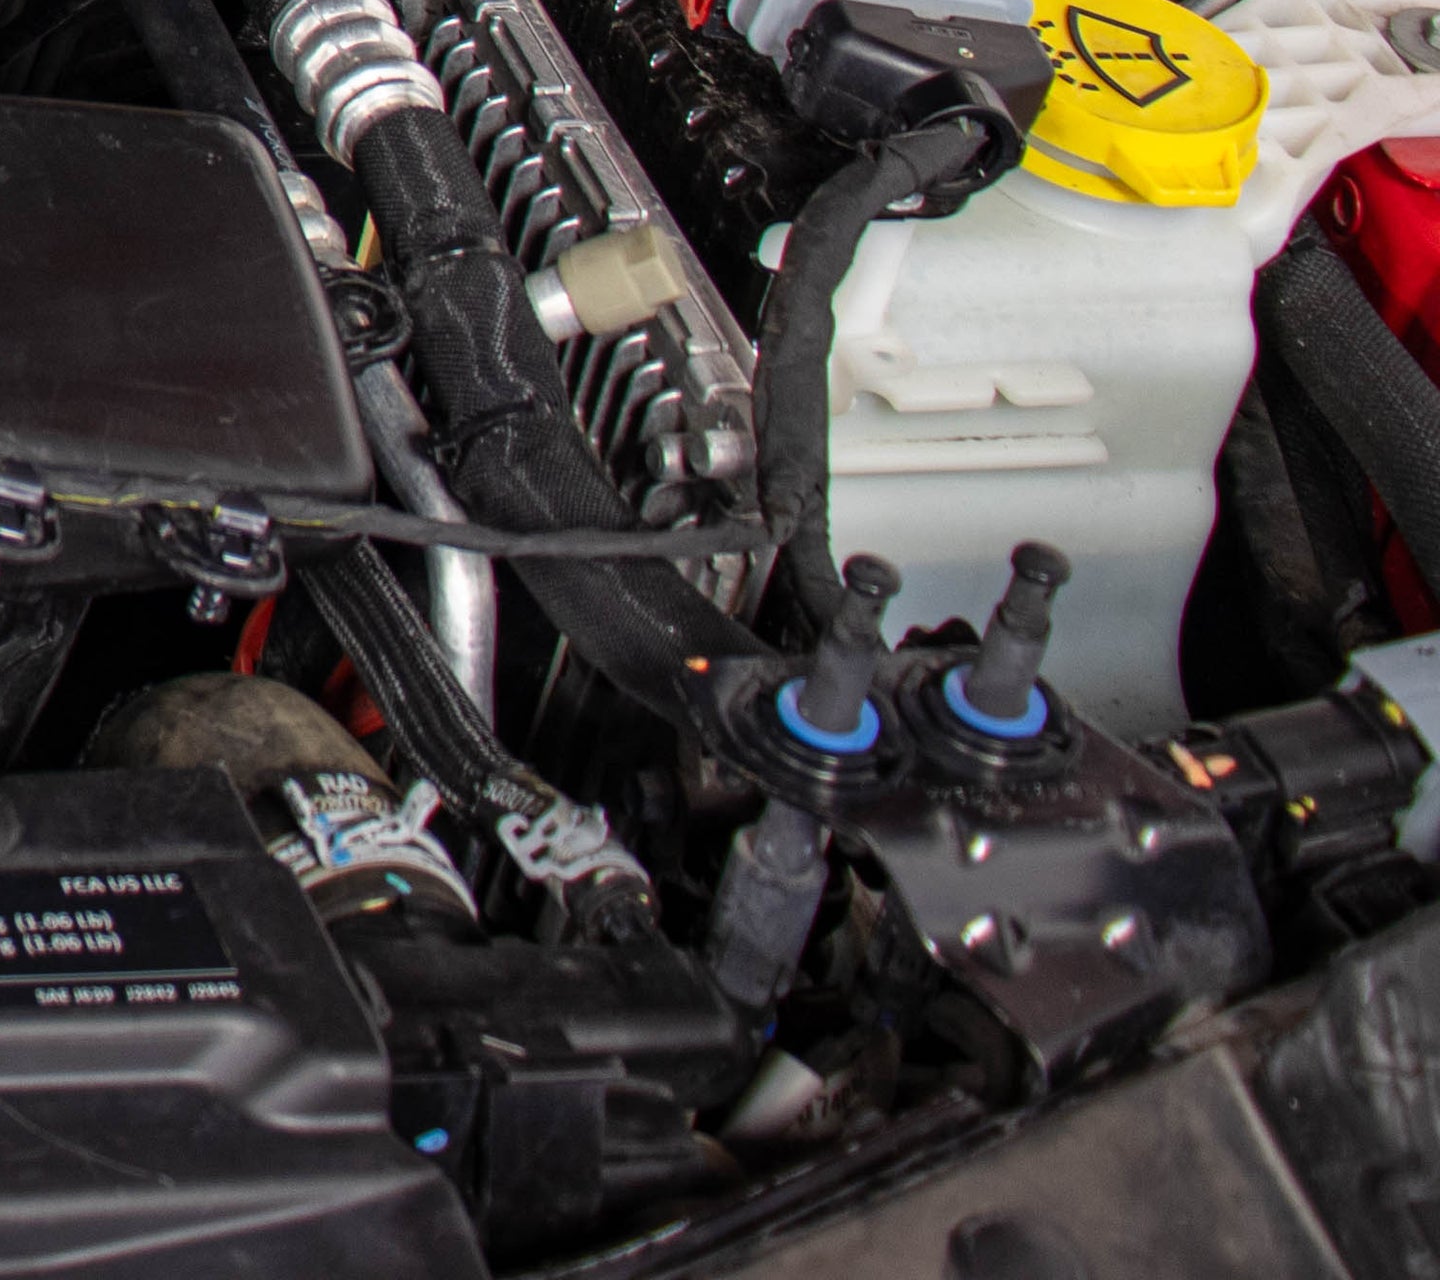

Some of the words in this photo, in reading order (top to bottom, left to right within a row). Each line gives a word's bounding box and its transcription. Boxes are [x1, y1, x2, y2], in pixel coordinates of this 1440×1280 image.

[60, 875, 107, 895] FCA
[107, 874, 142, 894] US
[142, 872, 183, 894] LLC
